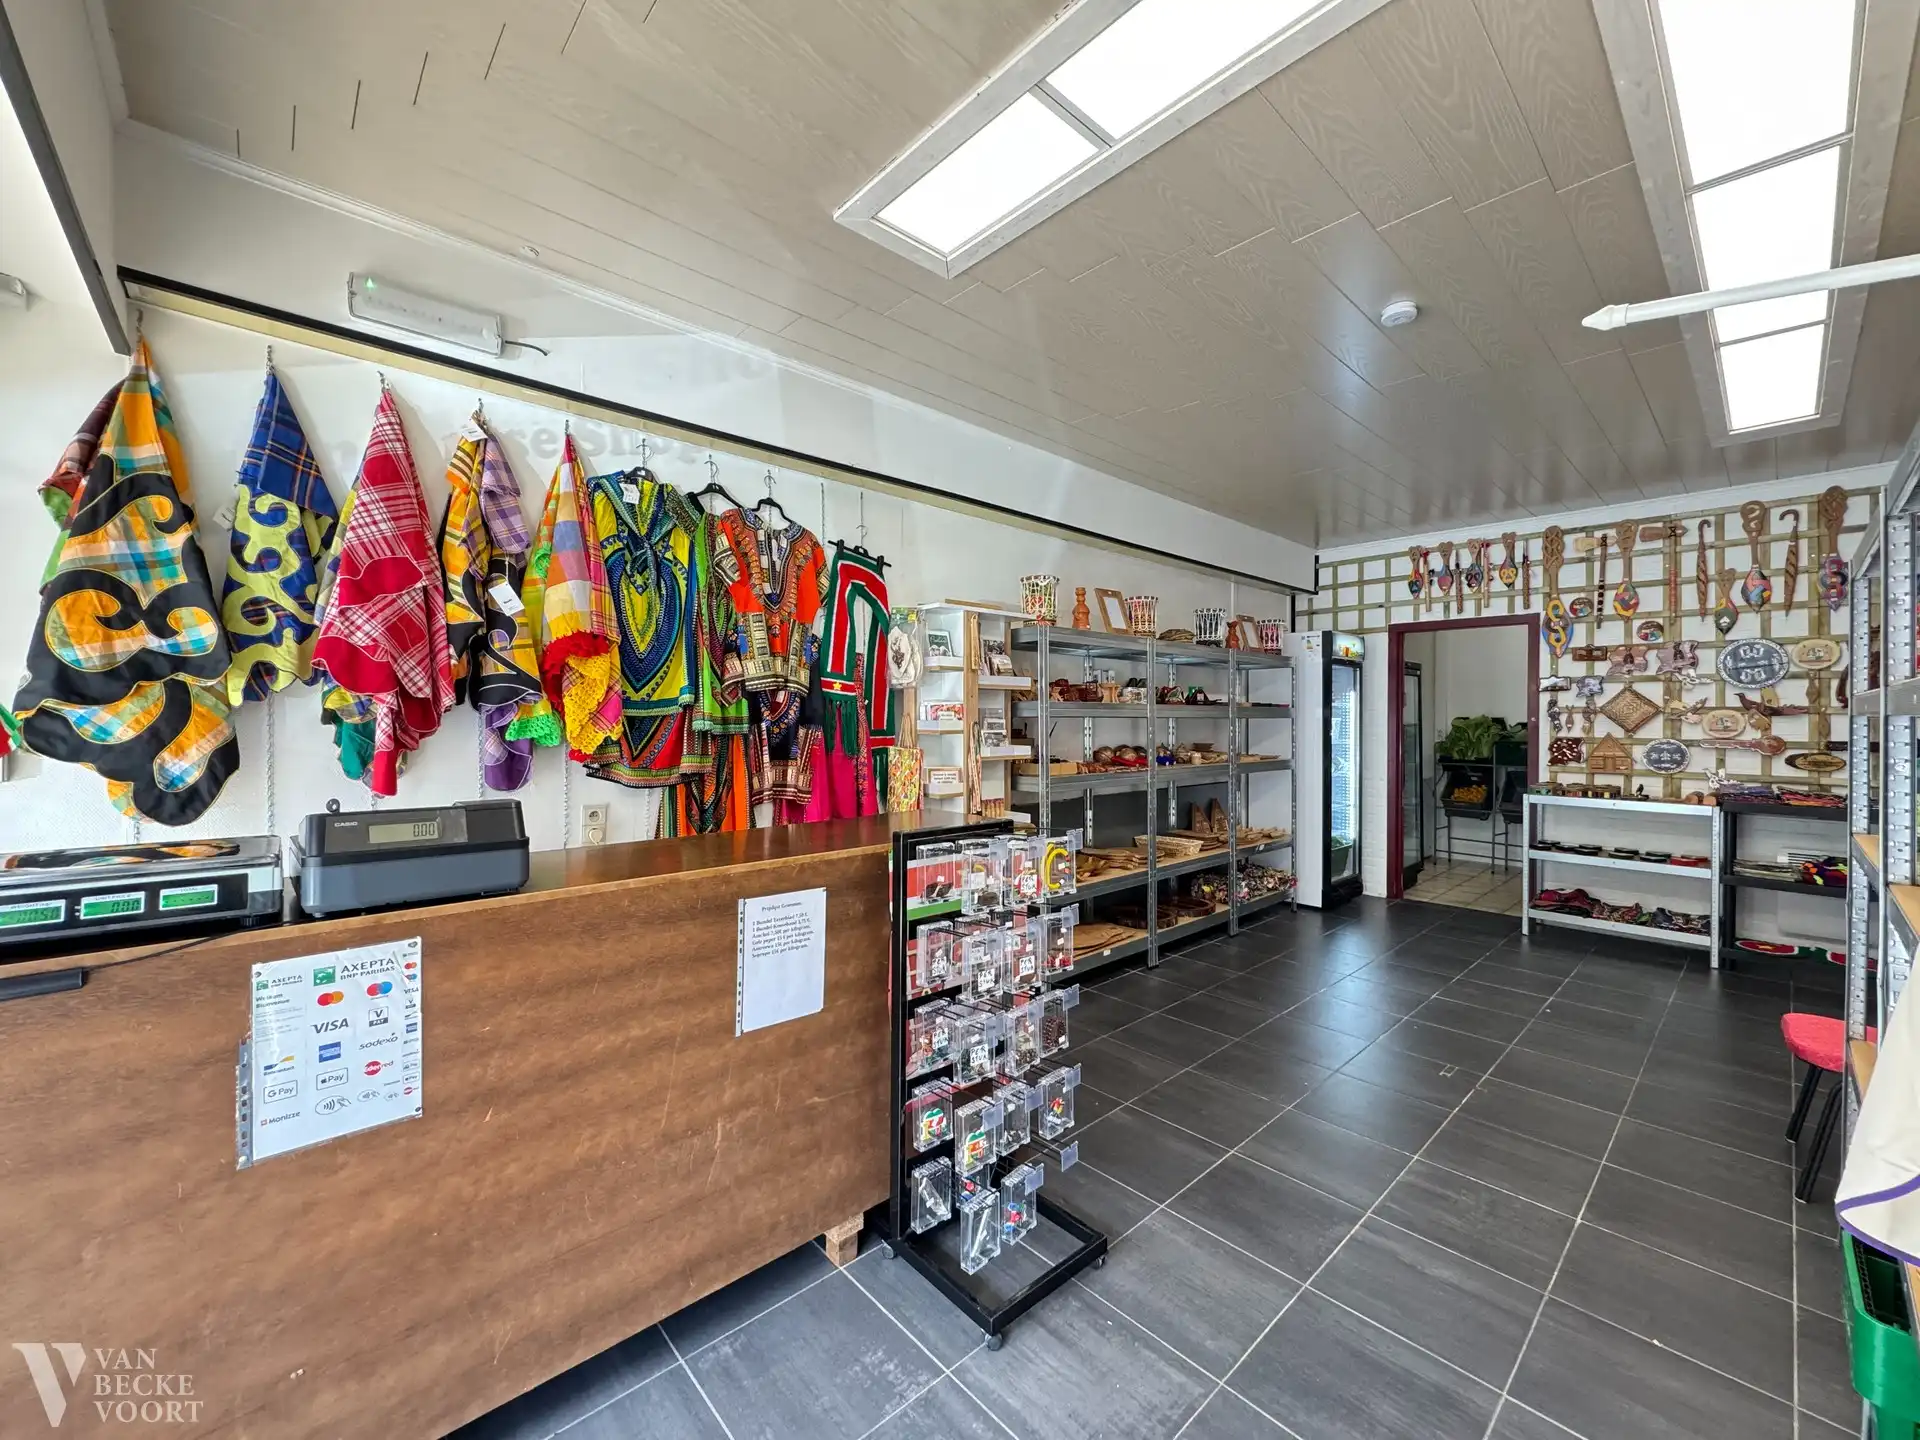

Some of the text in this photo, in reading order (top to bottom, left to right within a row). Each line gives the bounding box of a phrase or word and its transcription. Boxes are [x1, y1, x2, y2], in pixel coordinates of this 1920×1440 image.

[341, 958, 395, 974] AXEPTA
[360, 966, 395, 976] PARIBAS
[272, 974, 303, 984] AXEPTA
[310, 1017, 349, 1034] VISA
[359, 1033, 399, 1050] sodexo
[328, 1073, 344, 1083] Pay
[278, 1086, 294, 1096] Pay
